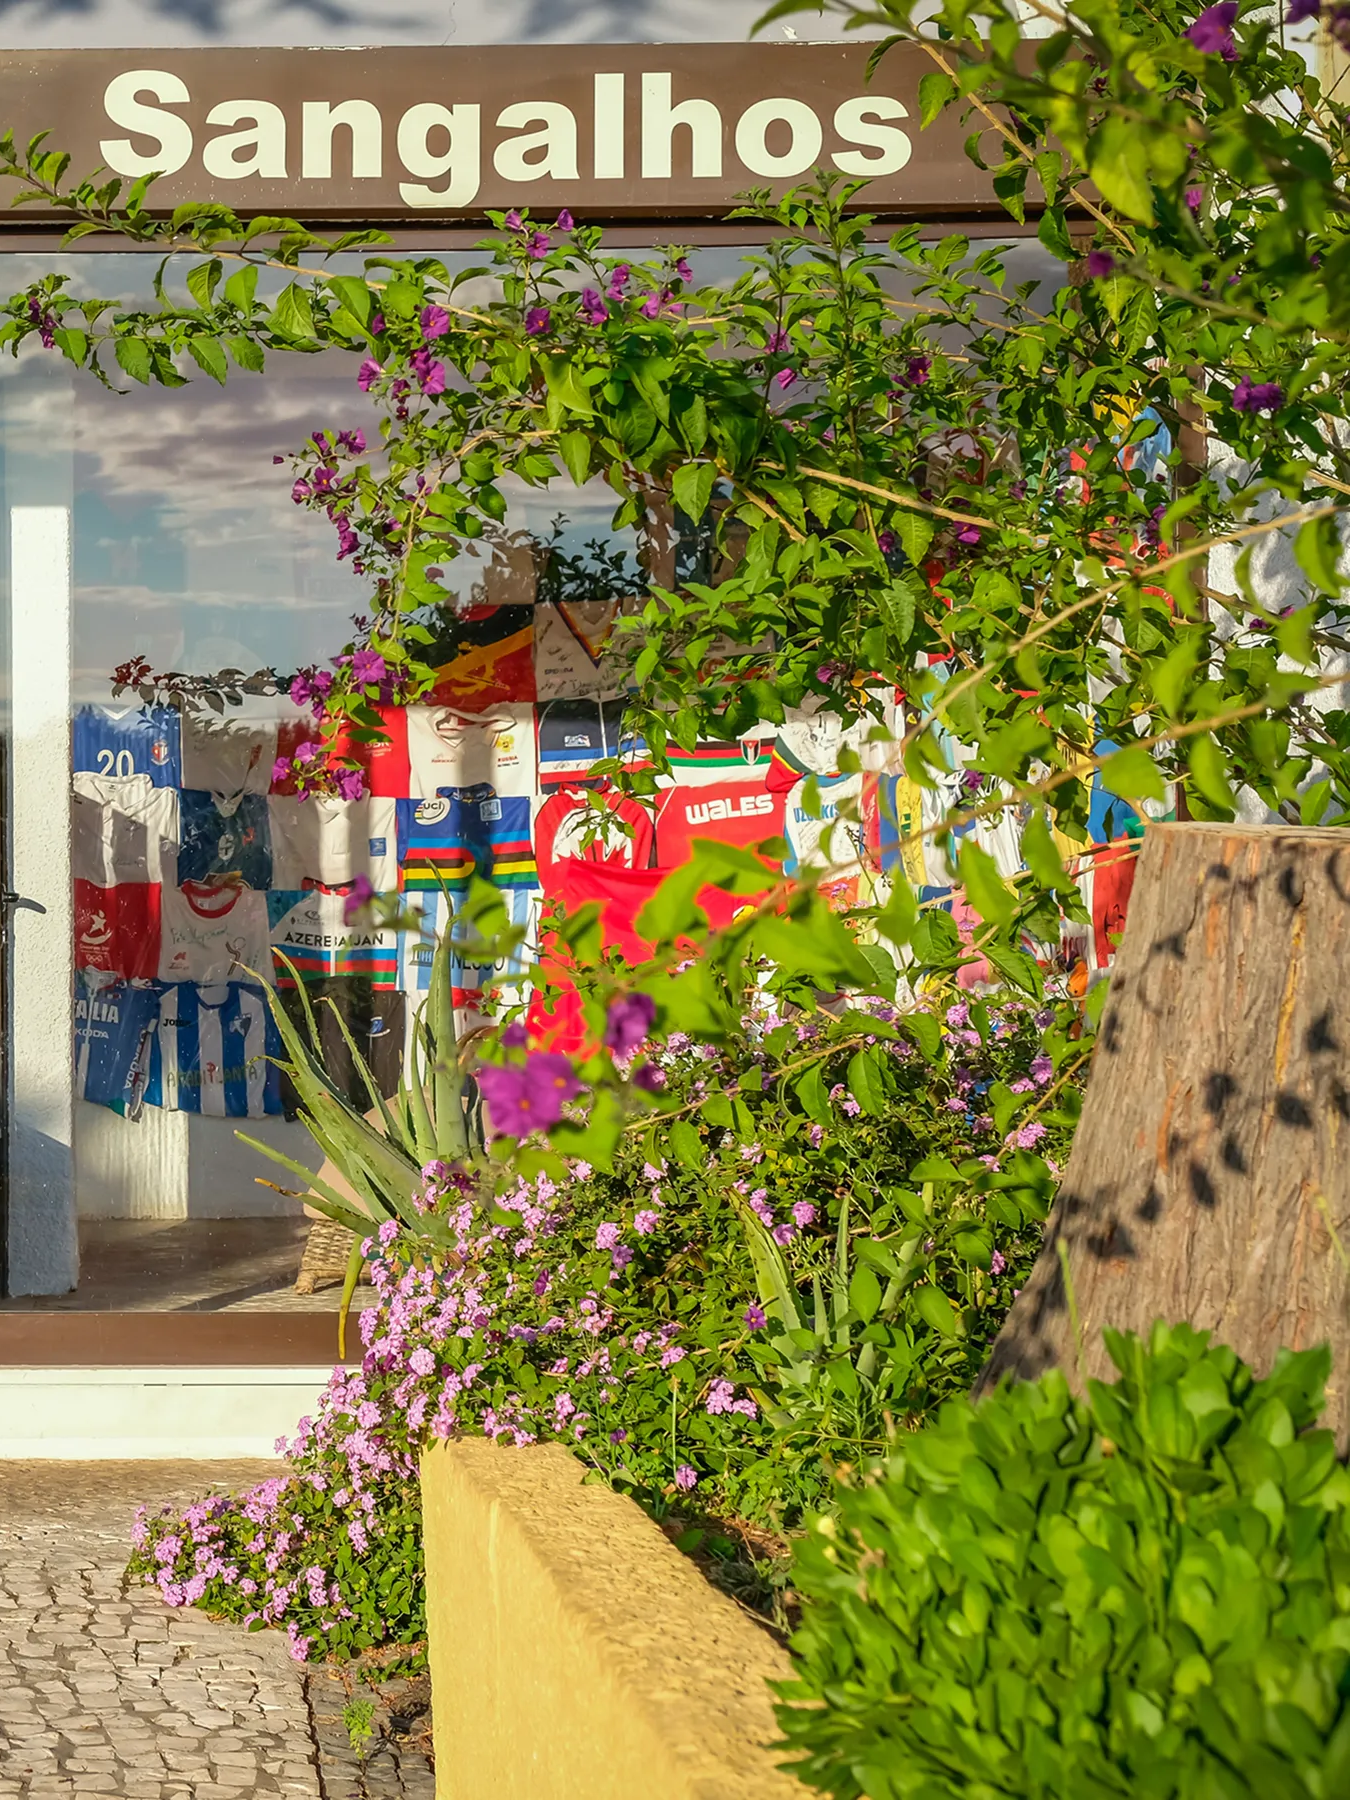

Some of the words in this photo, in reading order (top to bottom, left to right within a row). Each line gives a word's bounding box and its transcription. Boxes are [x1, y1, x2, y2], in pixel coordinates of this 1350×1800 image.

[99, 69, 913, 209] Sangalhos
[97, 749, 135, 778] 20
[284, 932, 384, 947] AZERBAJAN
